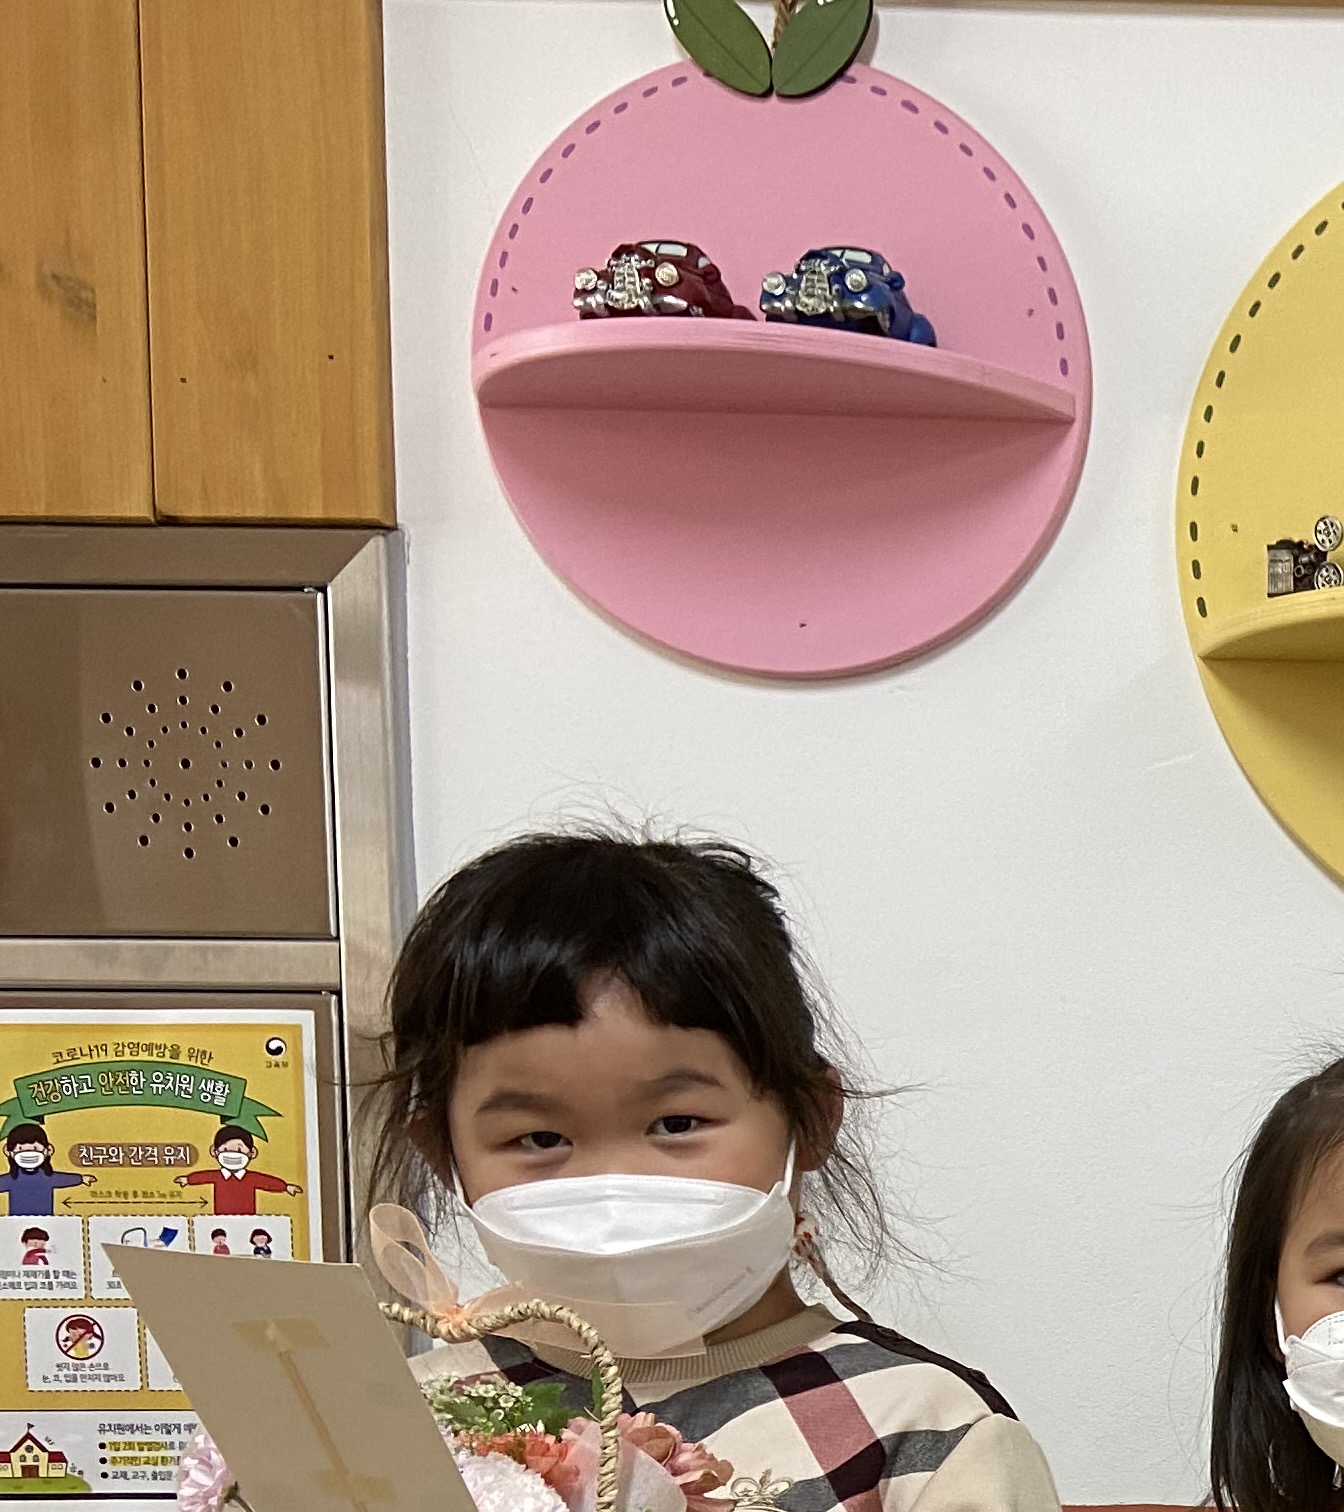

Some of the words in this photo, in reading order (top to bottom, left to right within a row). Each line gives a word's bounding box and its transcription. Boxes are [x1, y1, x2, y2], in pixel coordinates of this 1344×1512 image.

[52, 1043, 108, 1065] 코로나19
[187, 1047, 215, 1066] 위한
[28, 1075, 95, 1106] 건강하고
[98, 1070, 147, 1096] 안전한
[149, 1071, 194, 1098] 유치원
[198, 1078, 231, 1107] 생활
[78, 1145, 125, 1166] 친구와
[128, 1145, 159, 1166] 간격
[162, 1146, 191, 1166] 유지
